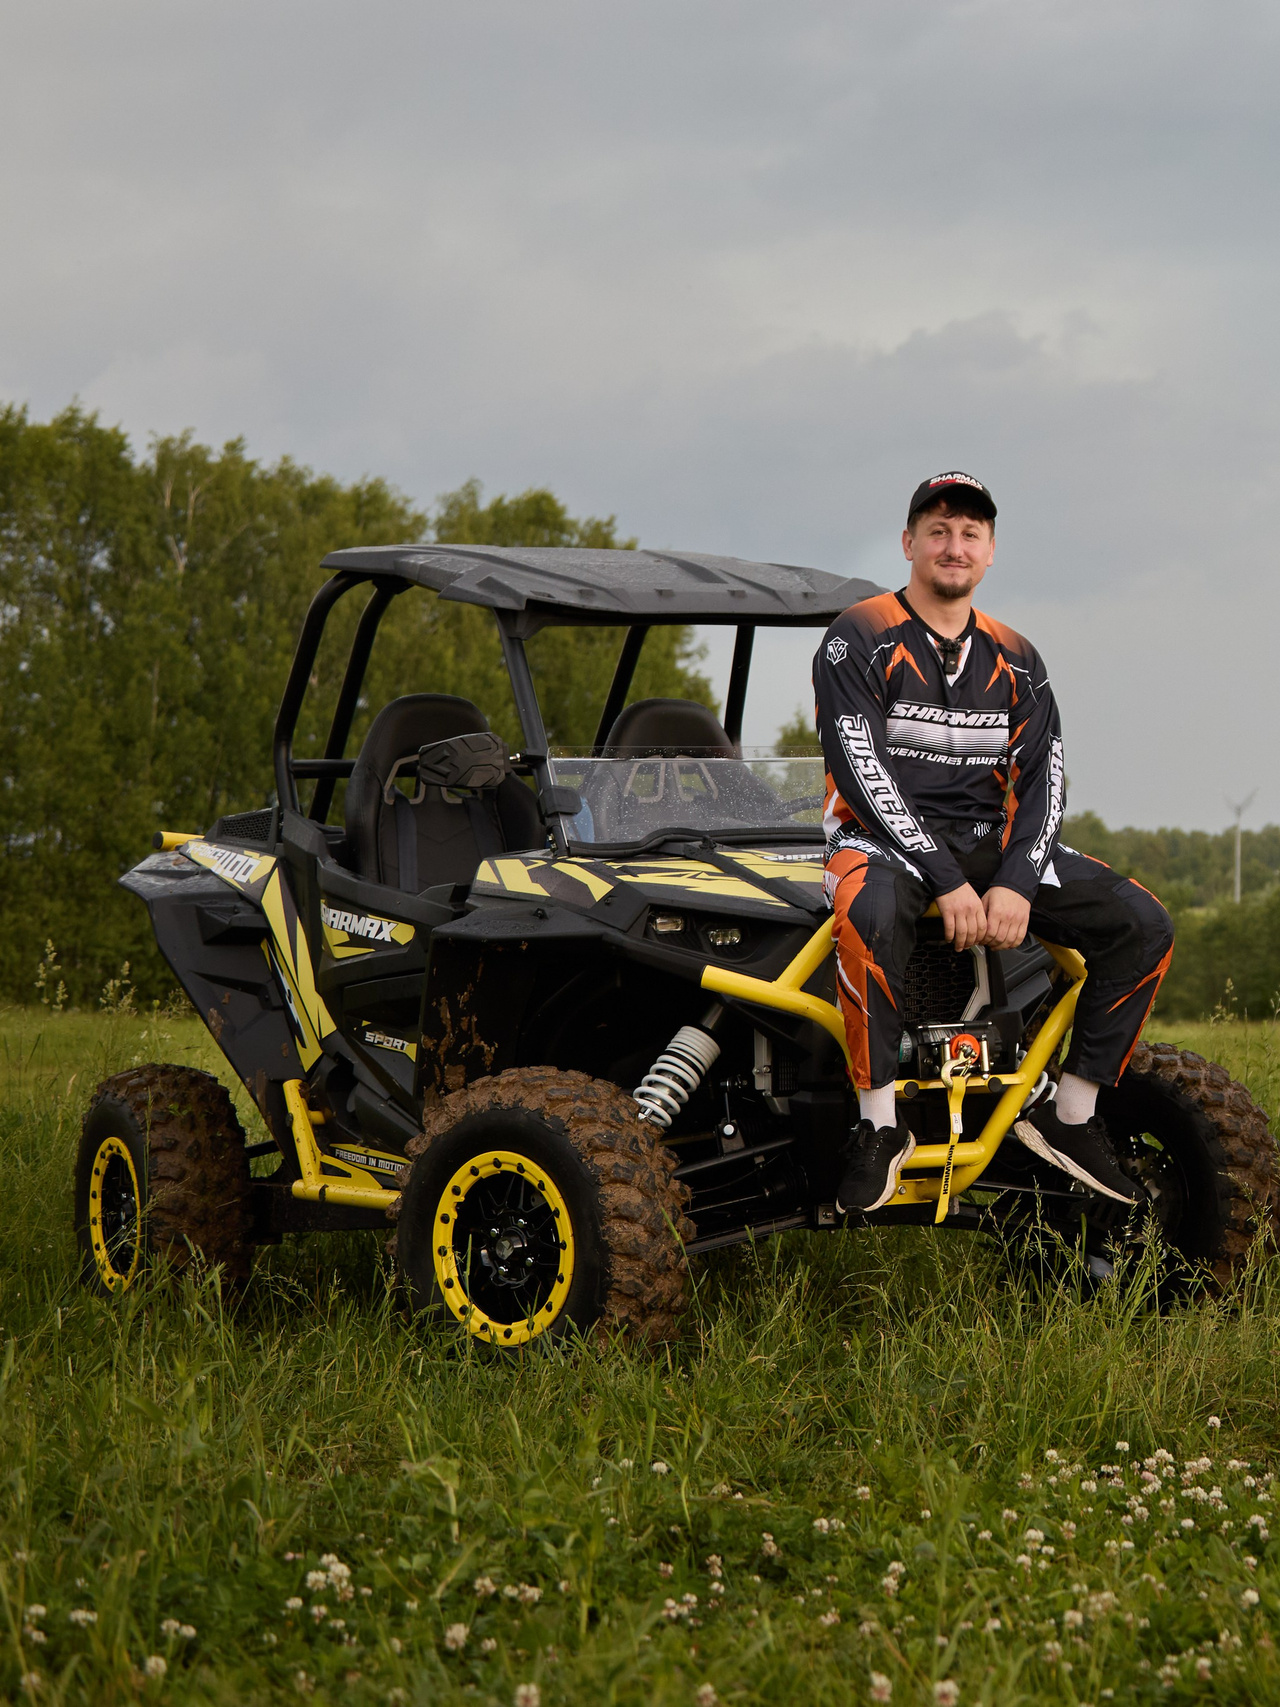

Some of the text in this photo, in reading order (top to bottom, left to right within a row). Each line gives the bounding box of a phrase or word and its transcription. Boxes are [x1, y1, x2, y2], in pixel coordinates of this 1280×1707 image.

[929, 473, 983, 490] SHARMAX
[890, 703, 1009, 728] SHARMAX
[210, 850, 261, 883] 1100
[365, 1031, 410, 1051] SPORT
[335, 1148, 367, 1164] FREEDOM
[368, 1156, 377, 1167] IN
[942, 1144, 955, 1195] NOVAWINCH
